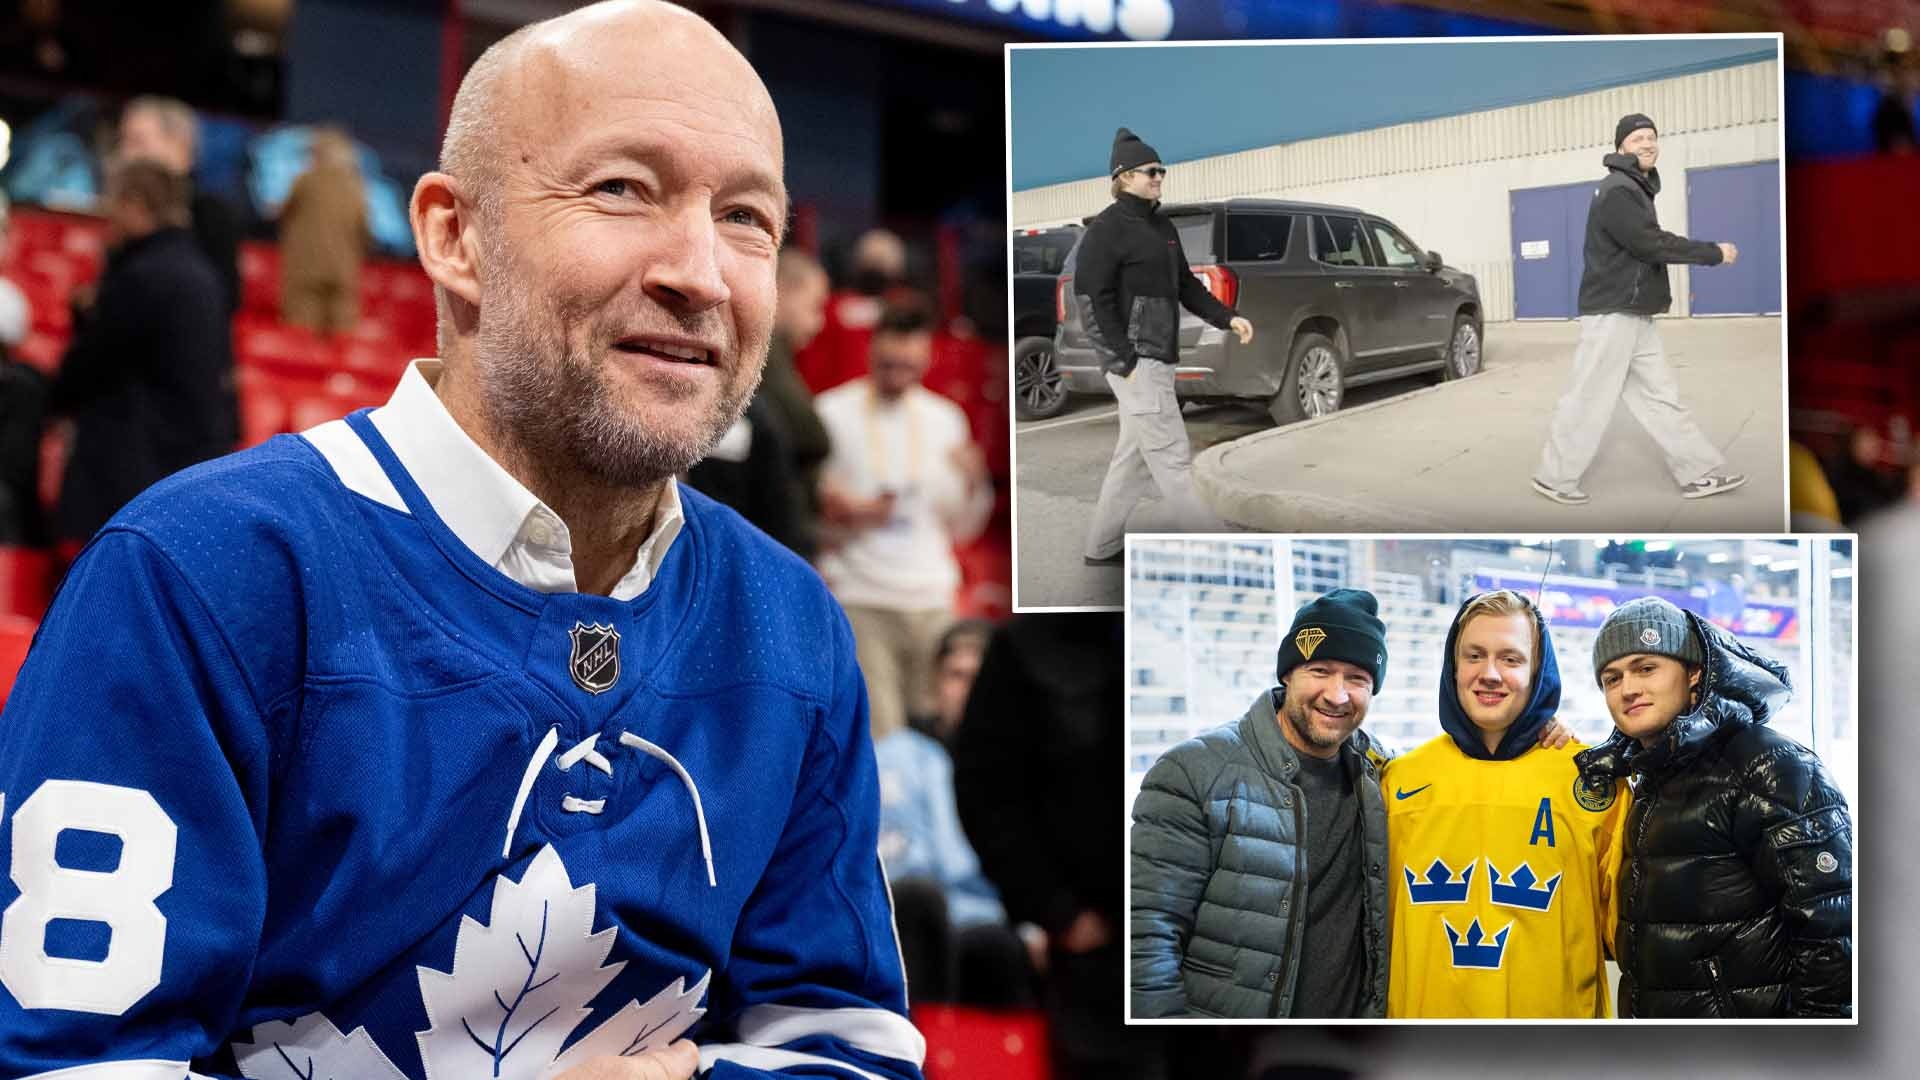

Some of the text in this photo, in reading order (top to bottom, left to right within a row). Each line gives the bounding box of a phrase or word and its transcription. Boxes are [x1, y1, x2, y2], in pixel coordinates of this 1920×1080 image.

[583, 642, 612, 677] NHL
[1529, 797, 1555, 847] A
[0, 779, 178, 1016] 8
